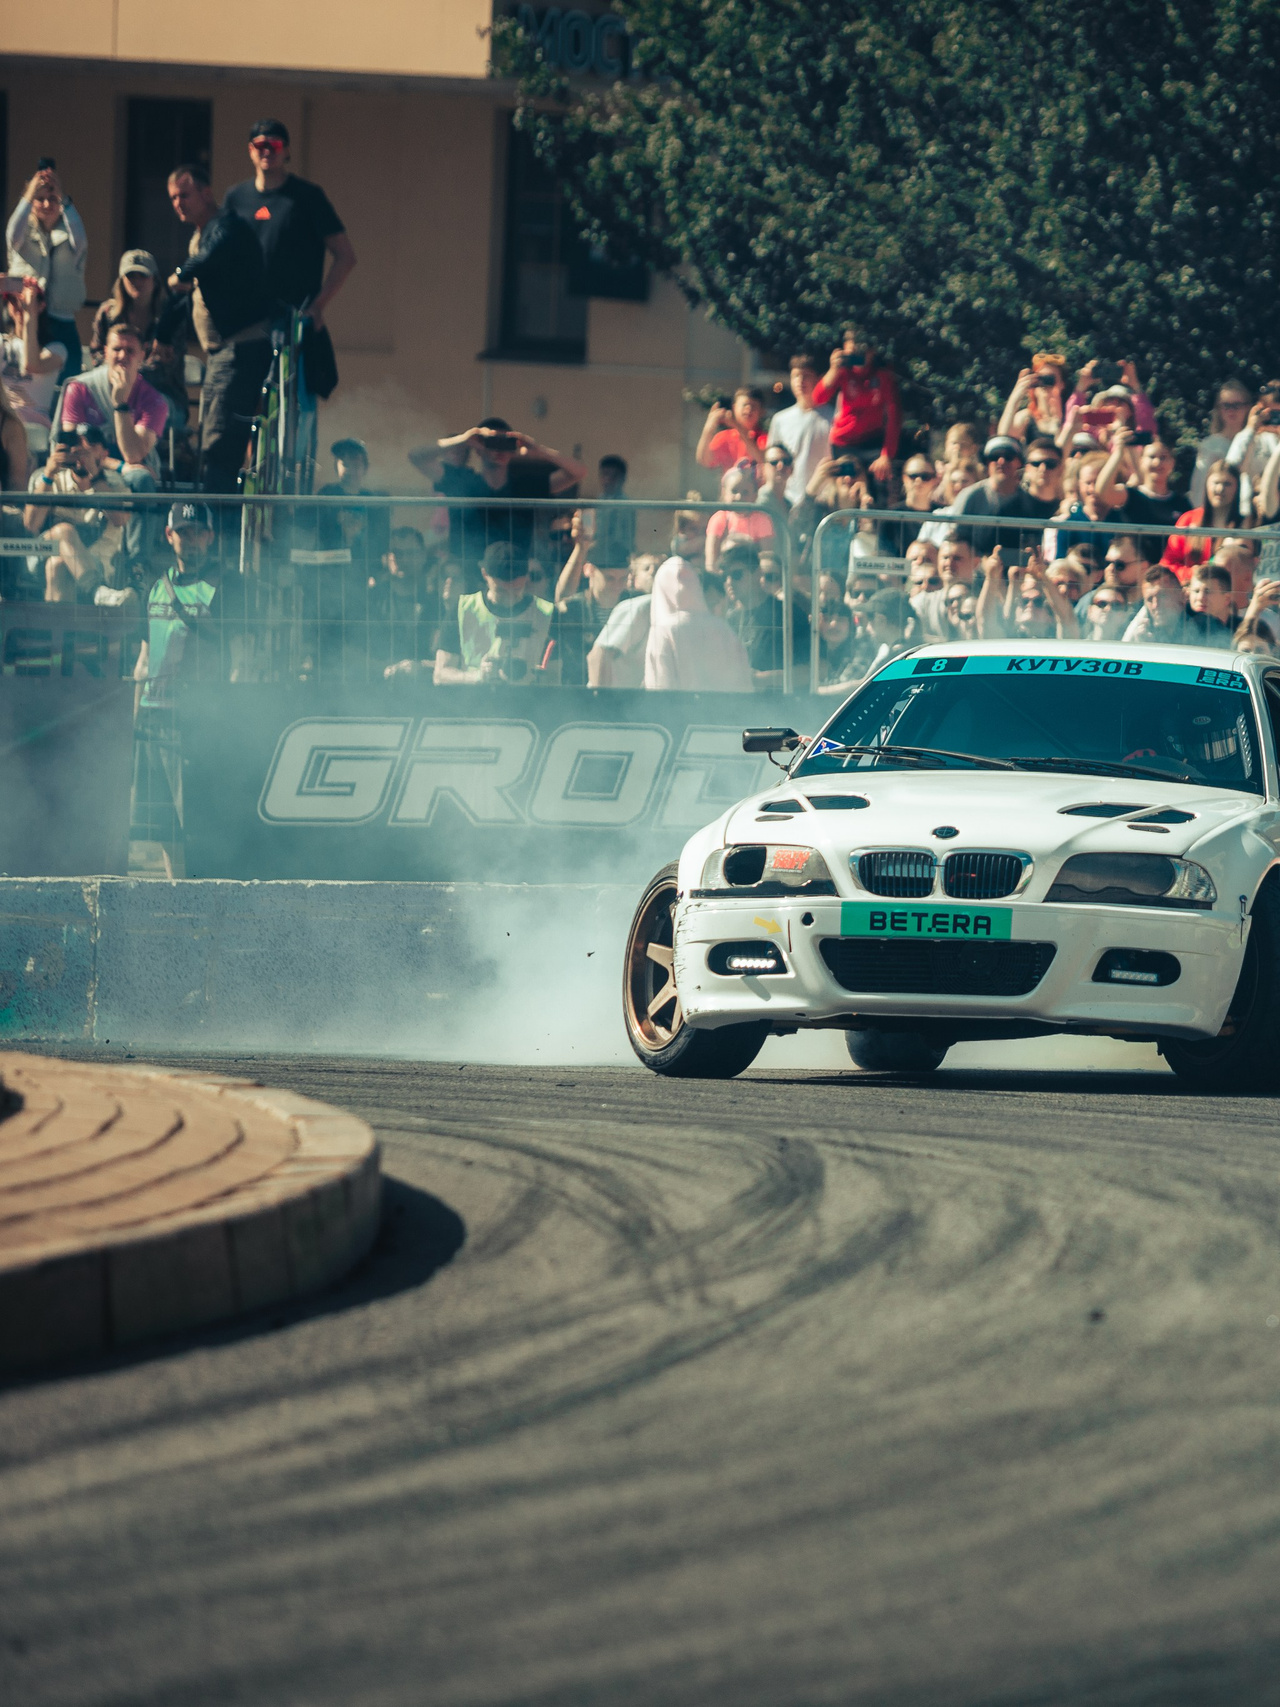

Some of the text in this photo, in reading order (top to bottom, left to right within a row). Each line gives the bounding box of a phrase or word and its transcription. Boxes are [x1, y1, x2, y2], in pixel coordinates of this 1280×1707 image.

[856, 561, 885, 569] GRAND
[931, 658, 948, 672] 8
[1006, 658, 1143, 676] КУТУЗОВ
[1203, 669, 1244, 682] BET
